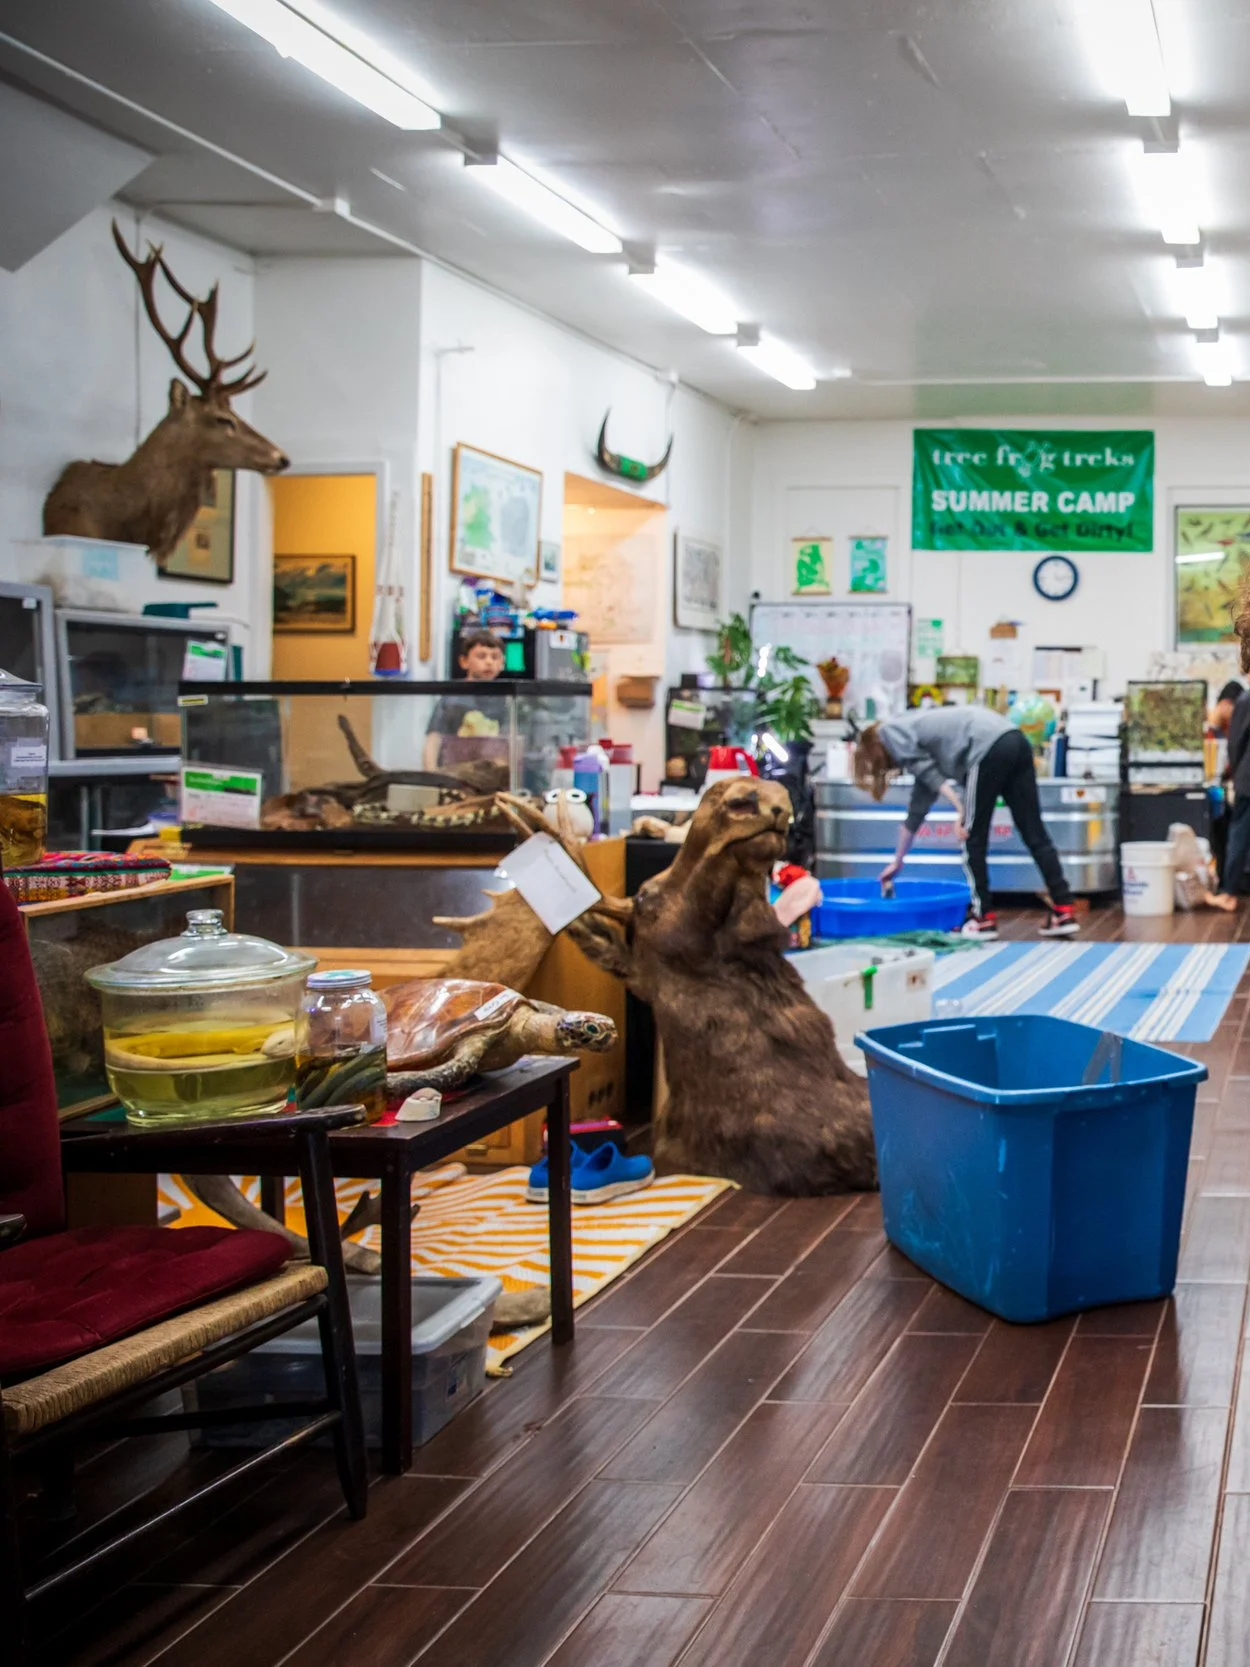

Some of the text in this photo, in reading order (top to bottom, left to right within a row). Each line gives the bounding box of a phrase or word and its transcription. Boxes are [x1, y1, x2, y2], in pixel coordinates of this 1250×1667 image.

[932, 448, 988, 467] tree
[1062, 447, 1135, 467] treks
[931, 489, 1136, 513] SUMMER CAMP
[1034, 520, 1070, 538] Get
[1075, 520, 1135, 543] Dirty!
